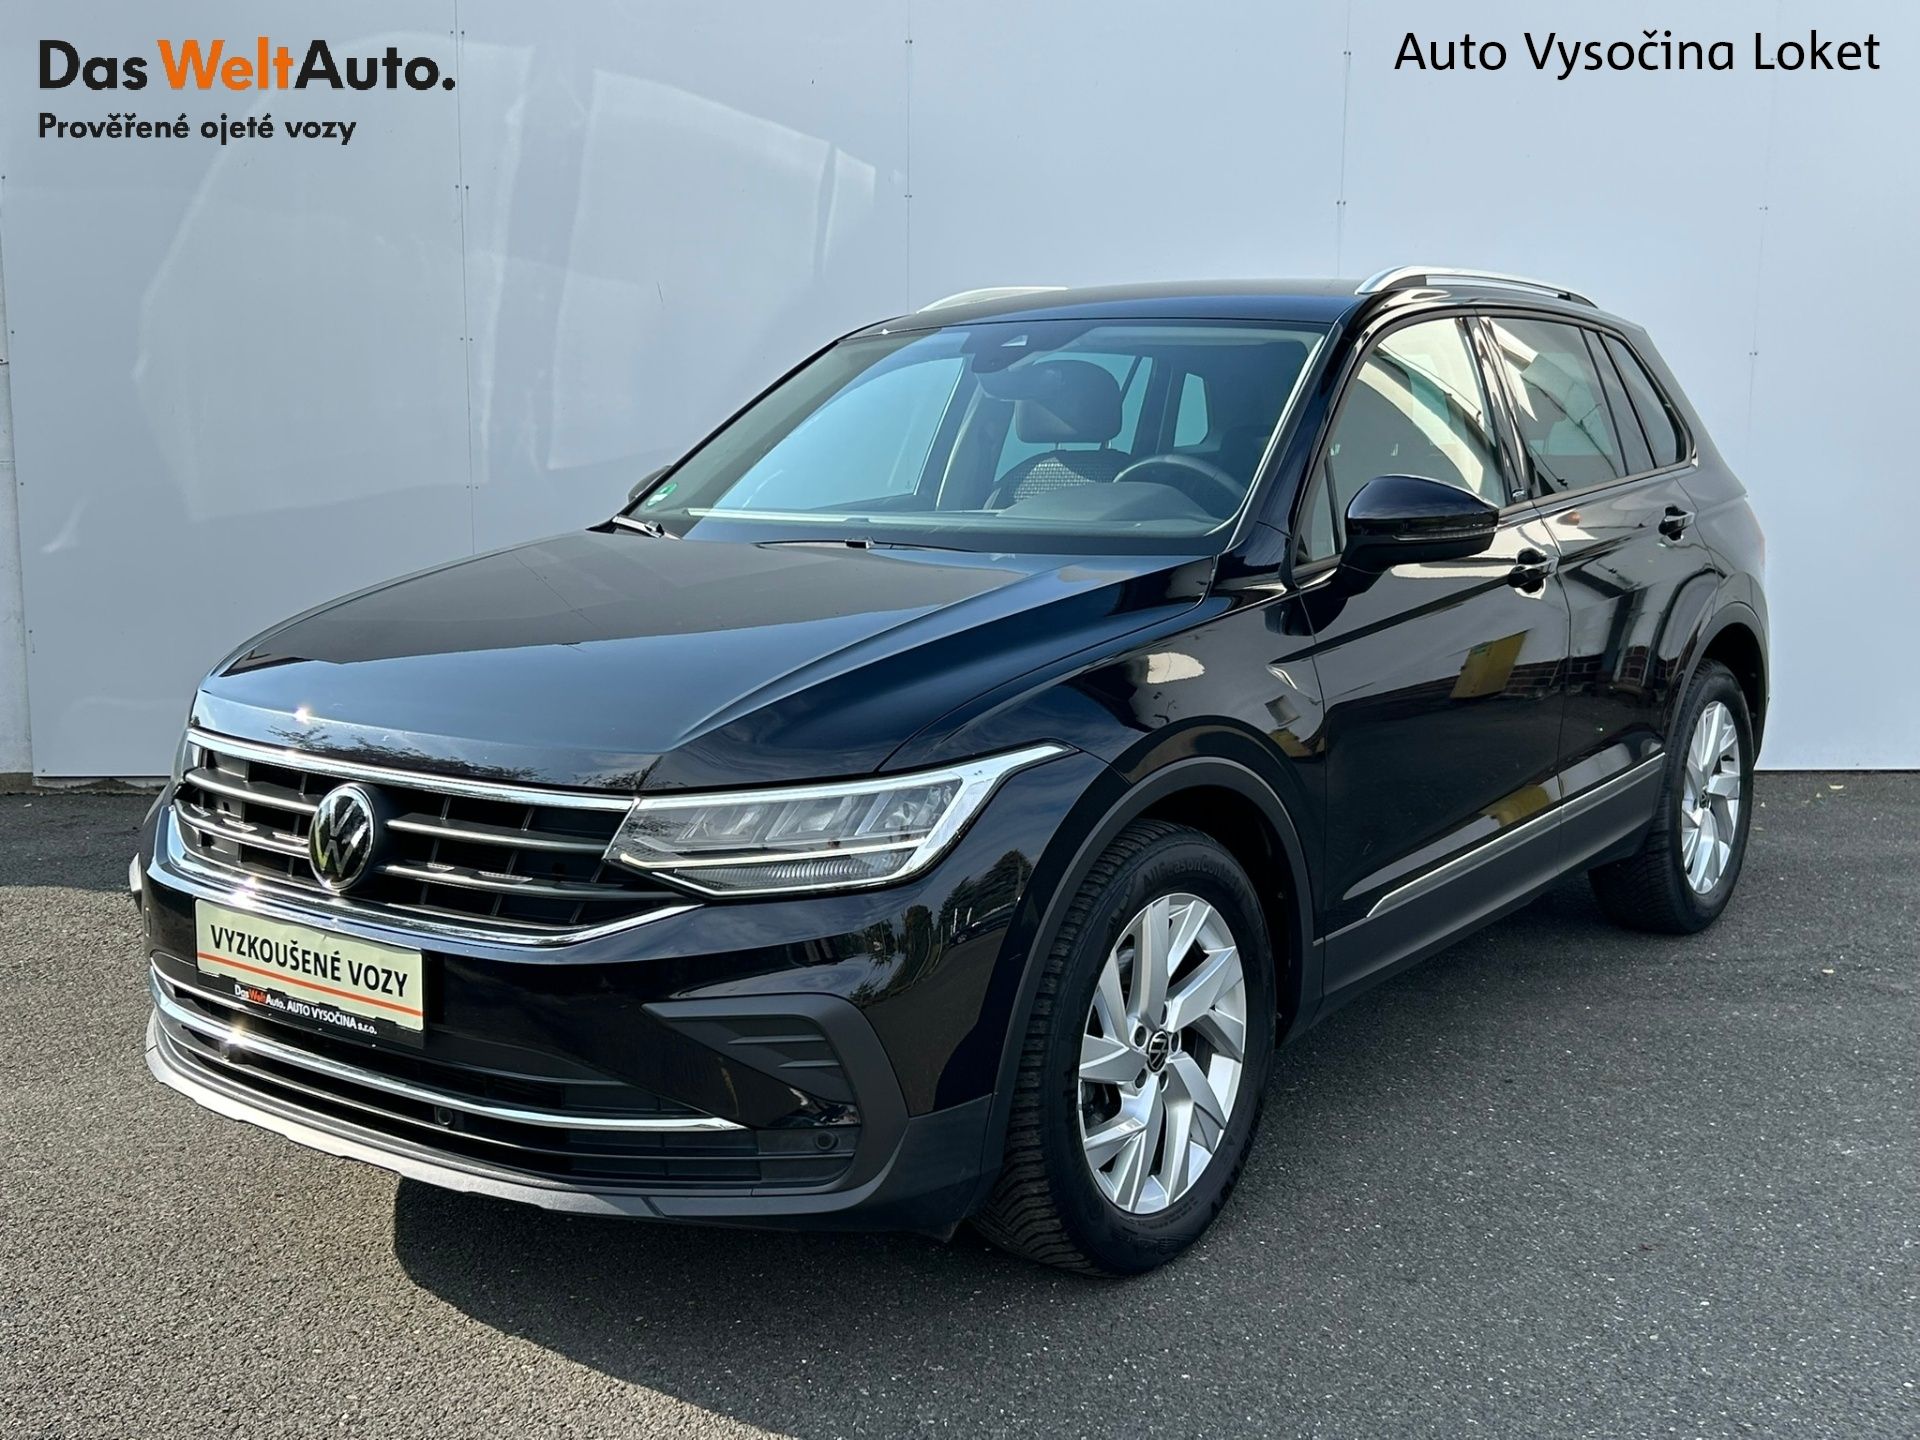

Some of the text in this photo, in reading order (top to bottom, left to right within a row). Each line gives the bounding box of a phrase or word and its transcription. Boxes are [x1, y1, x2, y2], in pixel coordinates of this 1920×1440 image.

[210, 924, 408, 997] VYZKOUŠENÉ VOZY
[287, 1000, 310, 1017] AUTO
[311, 1006, 357, 1029] VYSOČINA
[358, 1022, 378, 1035] s.r.o.
